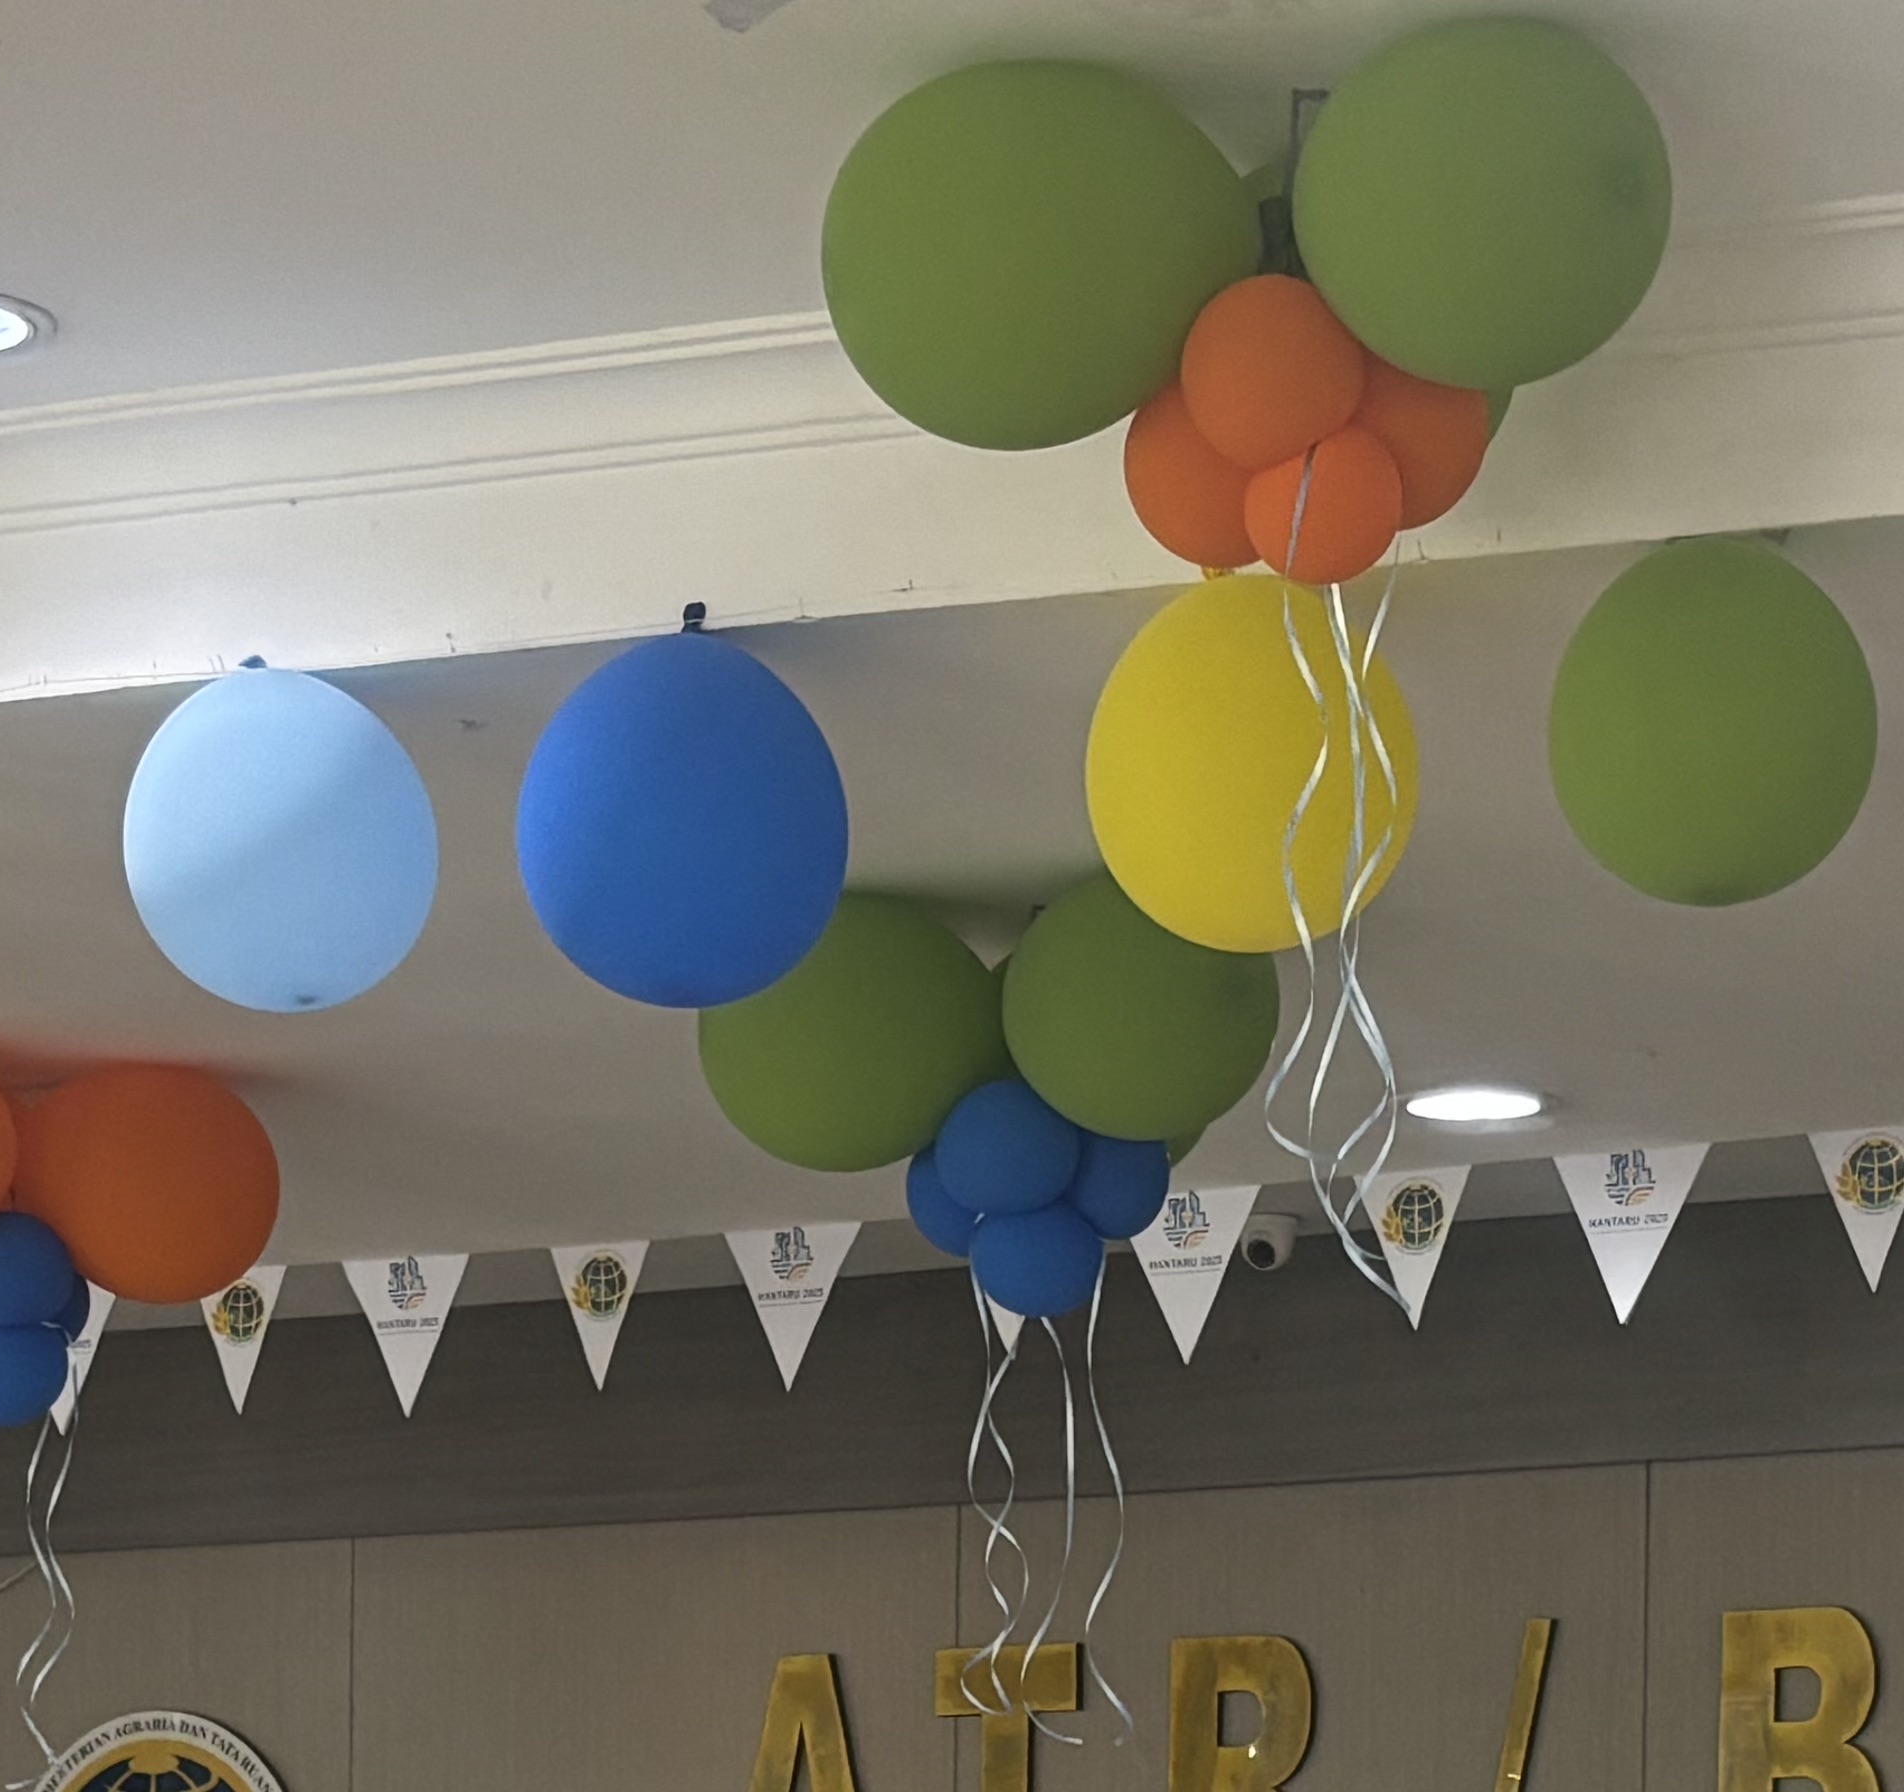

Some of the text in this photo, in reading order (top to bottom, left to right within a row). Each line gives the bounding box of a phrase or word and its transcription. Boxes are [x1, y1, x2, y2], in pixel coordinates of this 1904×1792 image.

[114, 1718, 176, 1740] AGRARIA
[180, 1719, 207, 1740] DAN
[211, 1732, 240, 1761] TATA
